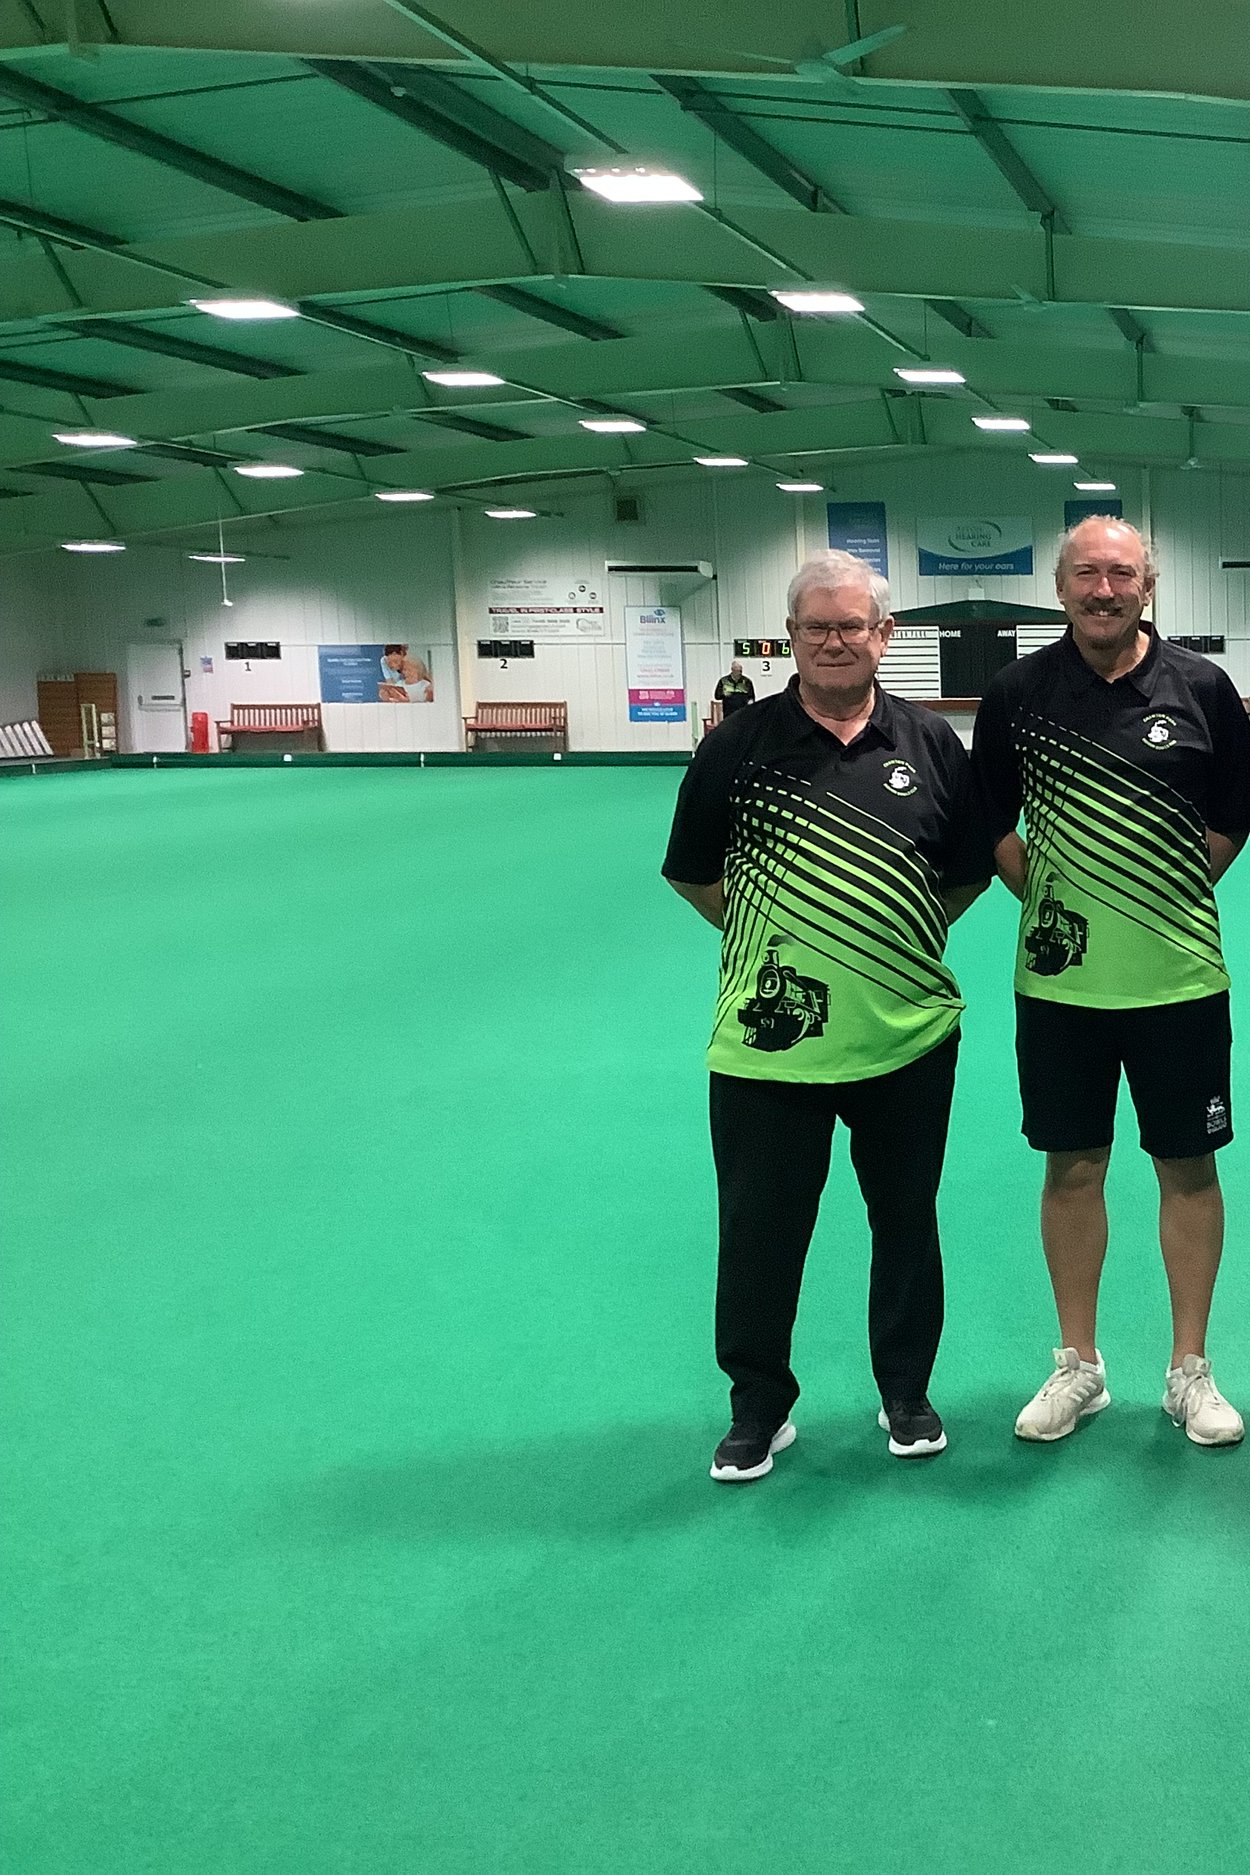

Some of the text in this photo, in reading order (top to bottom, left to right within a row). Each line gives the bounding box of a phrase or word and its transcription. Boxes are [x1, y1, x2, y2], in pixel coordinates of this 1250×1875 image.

[960, 562, 973, 570] for
[974, 563, 993, 572] your
[939, 630, 961, 638] HOME
[244, 661, 252, 672] 1
[500, 658, 508, 669] 2
[762, 660, 771, 672] 3
